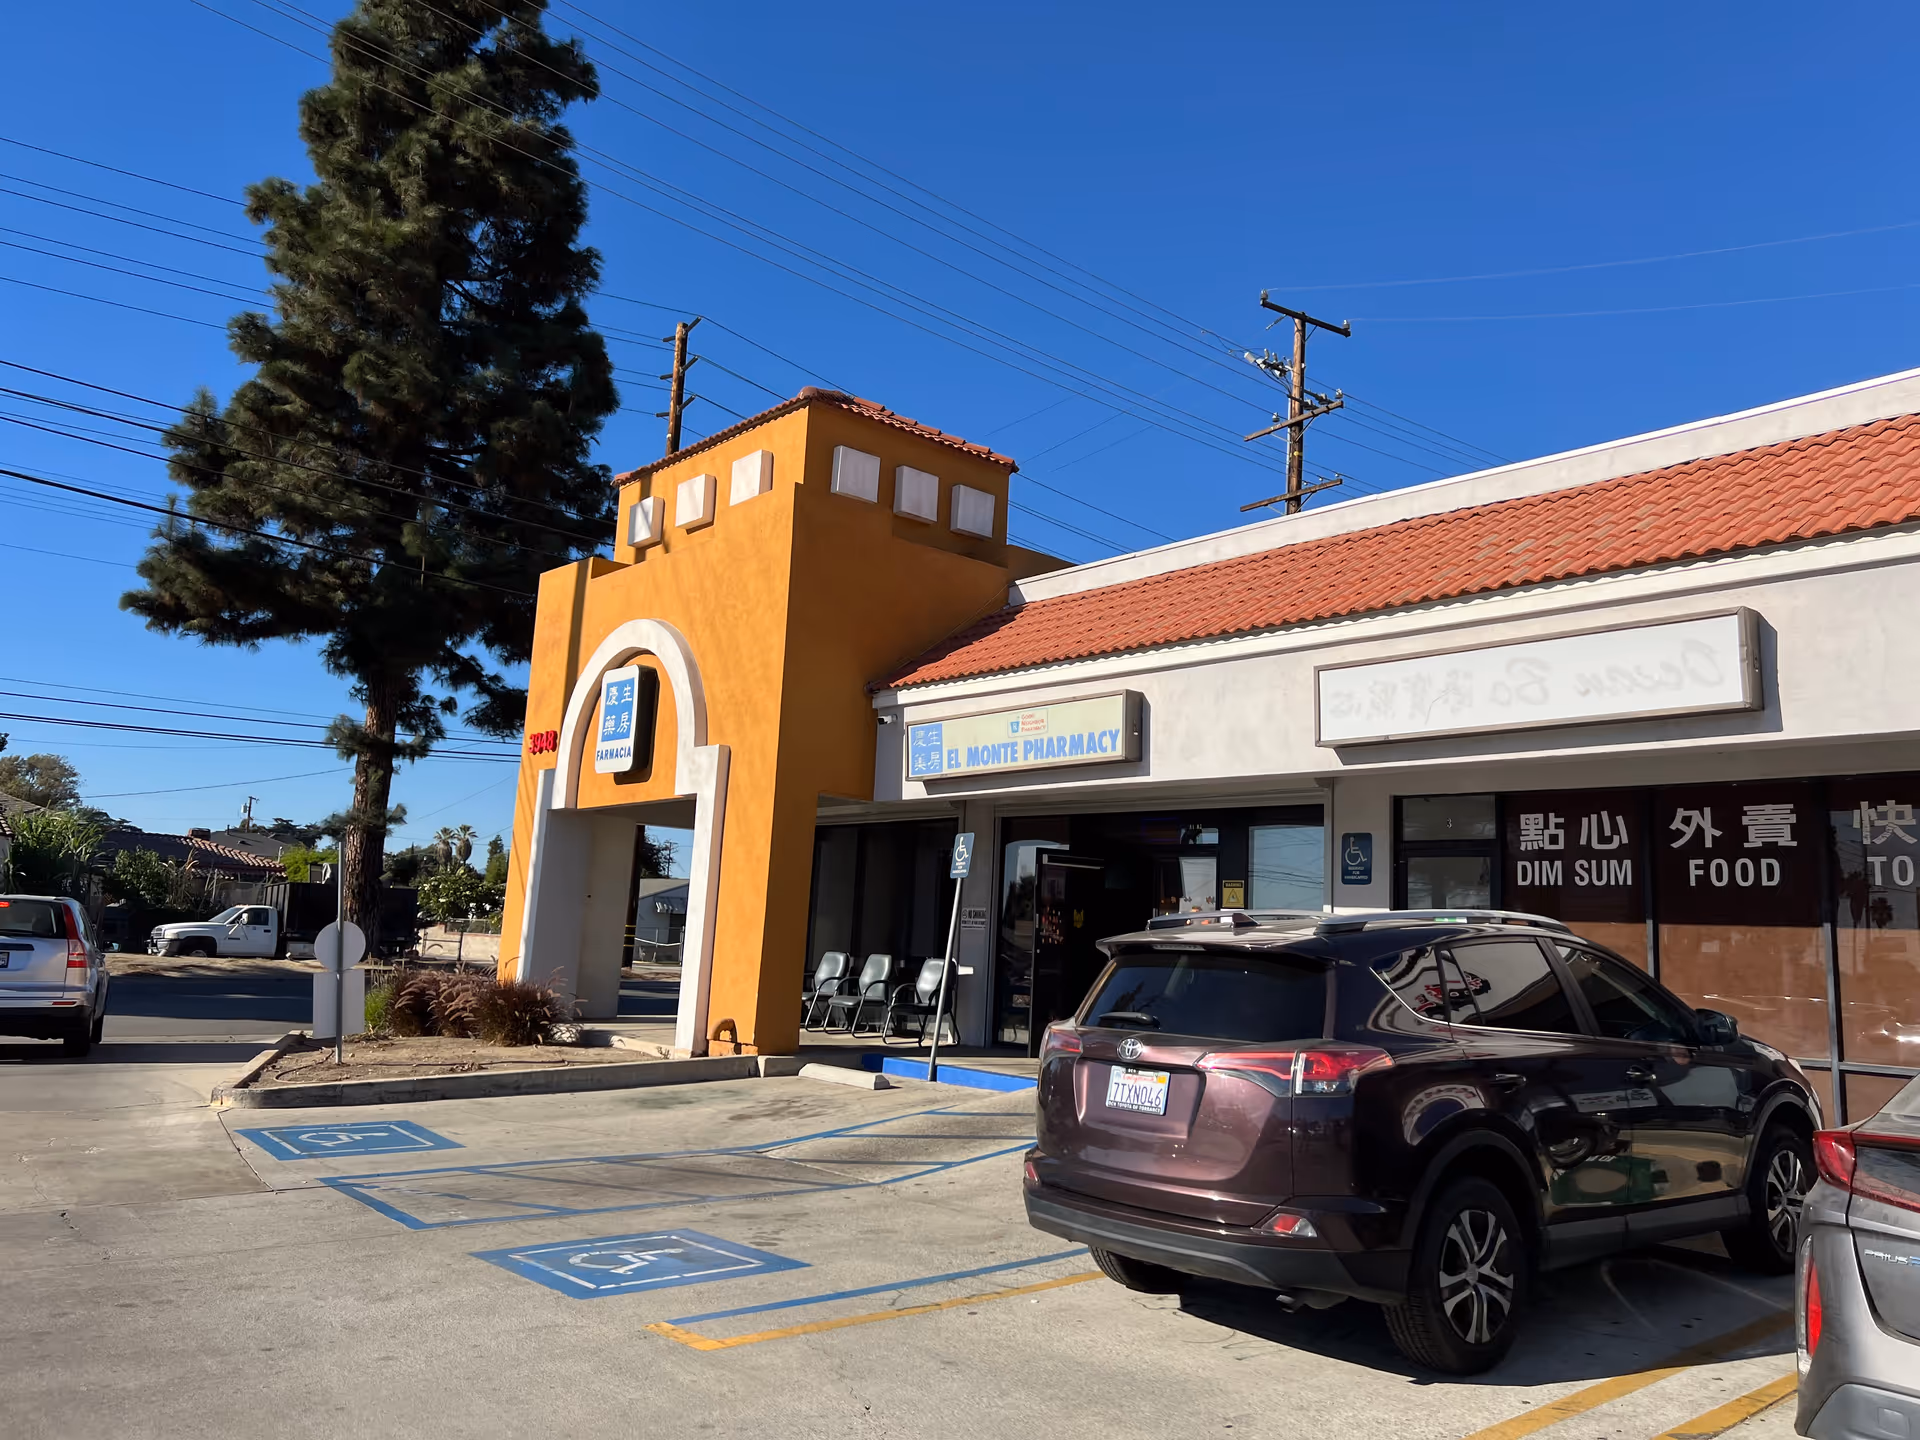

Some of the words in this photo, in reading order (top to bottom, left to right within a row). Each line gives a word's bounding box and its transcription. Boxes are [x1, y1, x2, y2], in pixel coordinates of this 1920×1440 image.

[606, 684, 633, 706] 慶生
[602, 711, 630, 736] 藥房
[528, 730, 557, 755] 3948
[596, 745, 632, 761] FARMACIA
[947, 748, 961, 769] EL
[966, 741, 1018, 768] MONTE
[1023, 729, 1121, 761] PHARMACY
[1446, 817, 1453, 829] 3
[1519, 810, 1629, 851] 點心
[1668, 803, 1798, 849] 外賣
[1852, 799, 1918, 845] 快
[1517, 860, 1563, 886] DIM
[1574, 859, 1633, 887] SUM
[1688, 857, 1781, 887] FOOD
[1866, 855, 1915, 886] TO
[1113, 1082, 1163, 1107] 7TXN046
[1864, 1249, 1908, 1265] PRIUS
